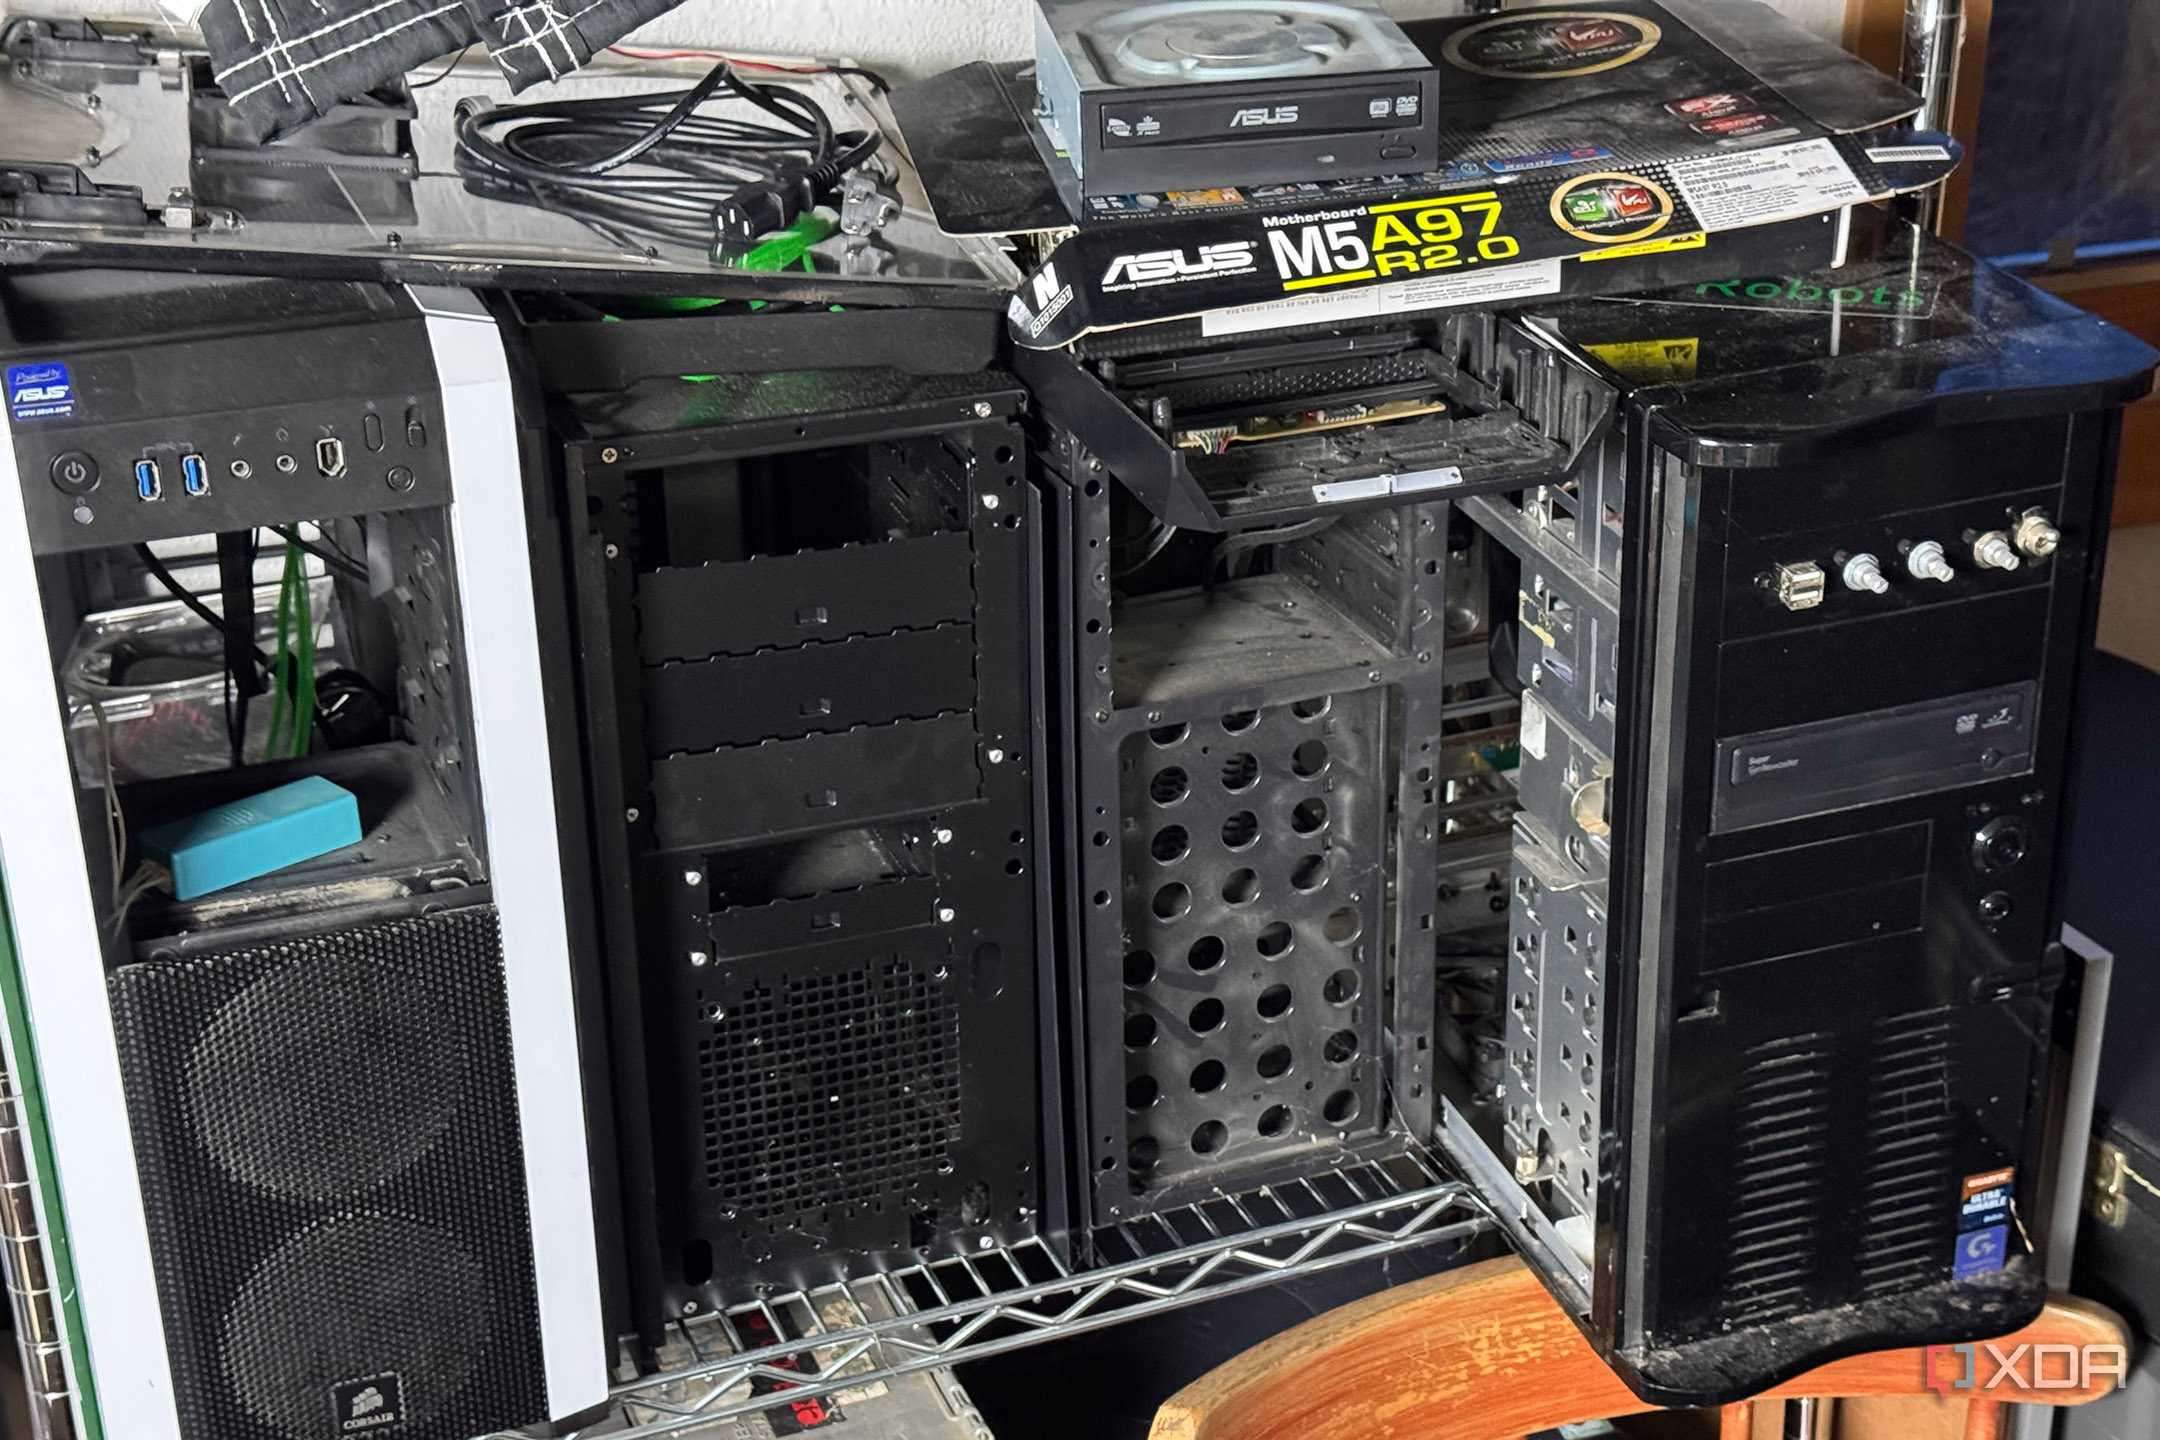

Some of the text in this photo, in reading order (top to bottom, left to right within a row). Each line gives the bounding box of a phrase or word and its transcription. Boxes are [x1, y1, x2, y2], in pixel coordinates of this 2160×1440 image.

[1230, 105, 1299, 127] ASUS
[1262, 205, 1368, 229] Motherboard
[1101, 241, 1255, 287] ASUS
[1374, 235, 1520, 278] R2.0
[14, 384, 70, 403] ASUS
[343, 1412, 394, 1430] CORSAIR
